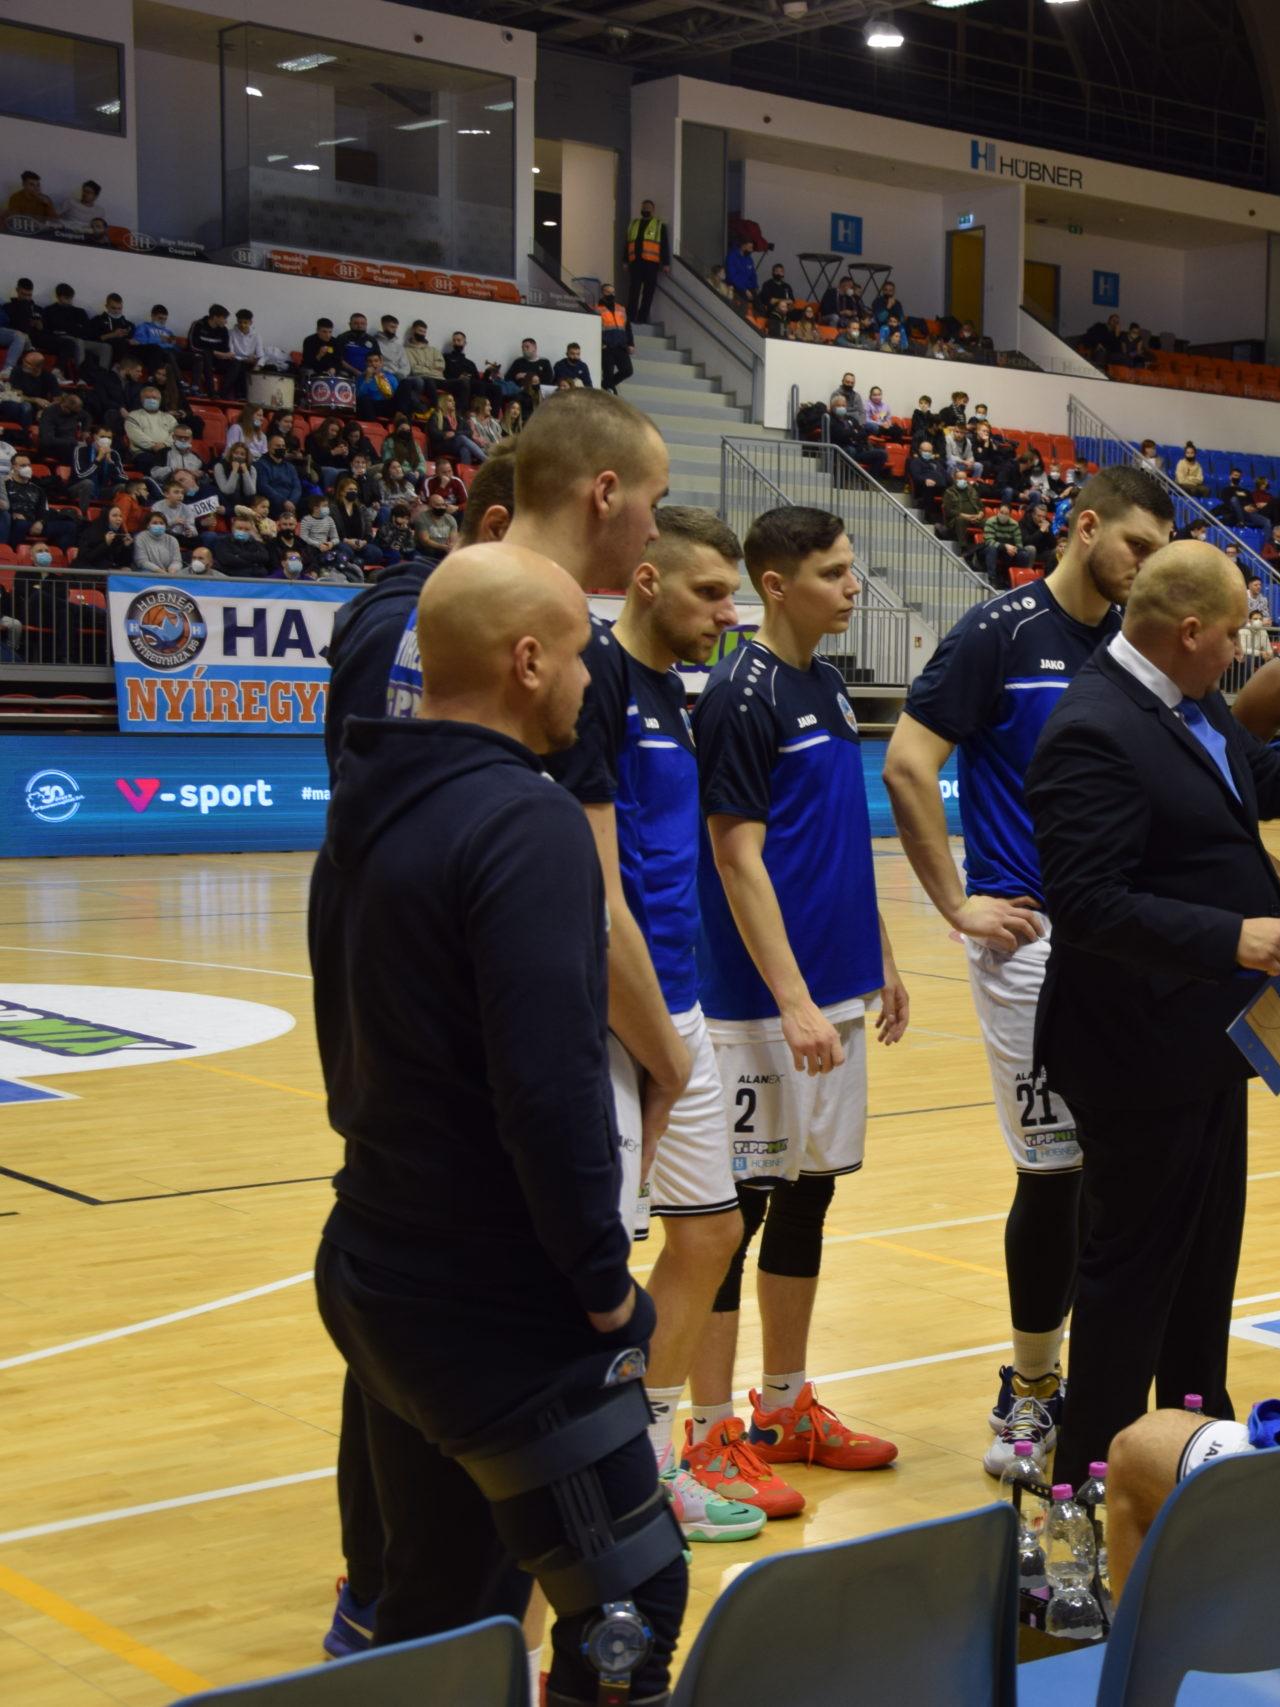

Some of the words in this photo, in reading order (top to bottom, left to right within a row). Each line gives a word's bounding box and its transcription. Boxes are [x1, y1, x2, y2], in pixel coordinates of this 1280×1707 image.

[999, 154, 1084, 189] HÜBNER
[222, 606, 330, 660] HA
[1039, 658, 1066, 671] JAKO
[125, 665, 330, 724] NYÍREGY
[301, 786, 331, 801] #ma
[734, 1087, 757, 1133] 2
[1016, 1083, 1059, 1128] 21
